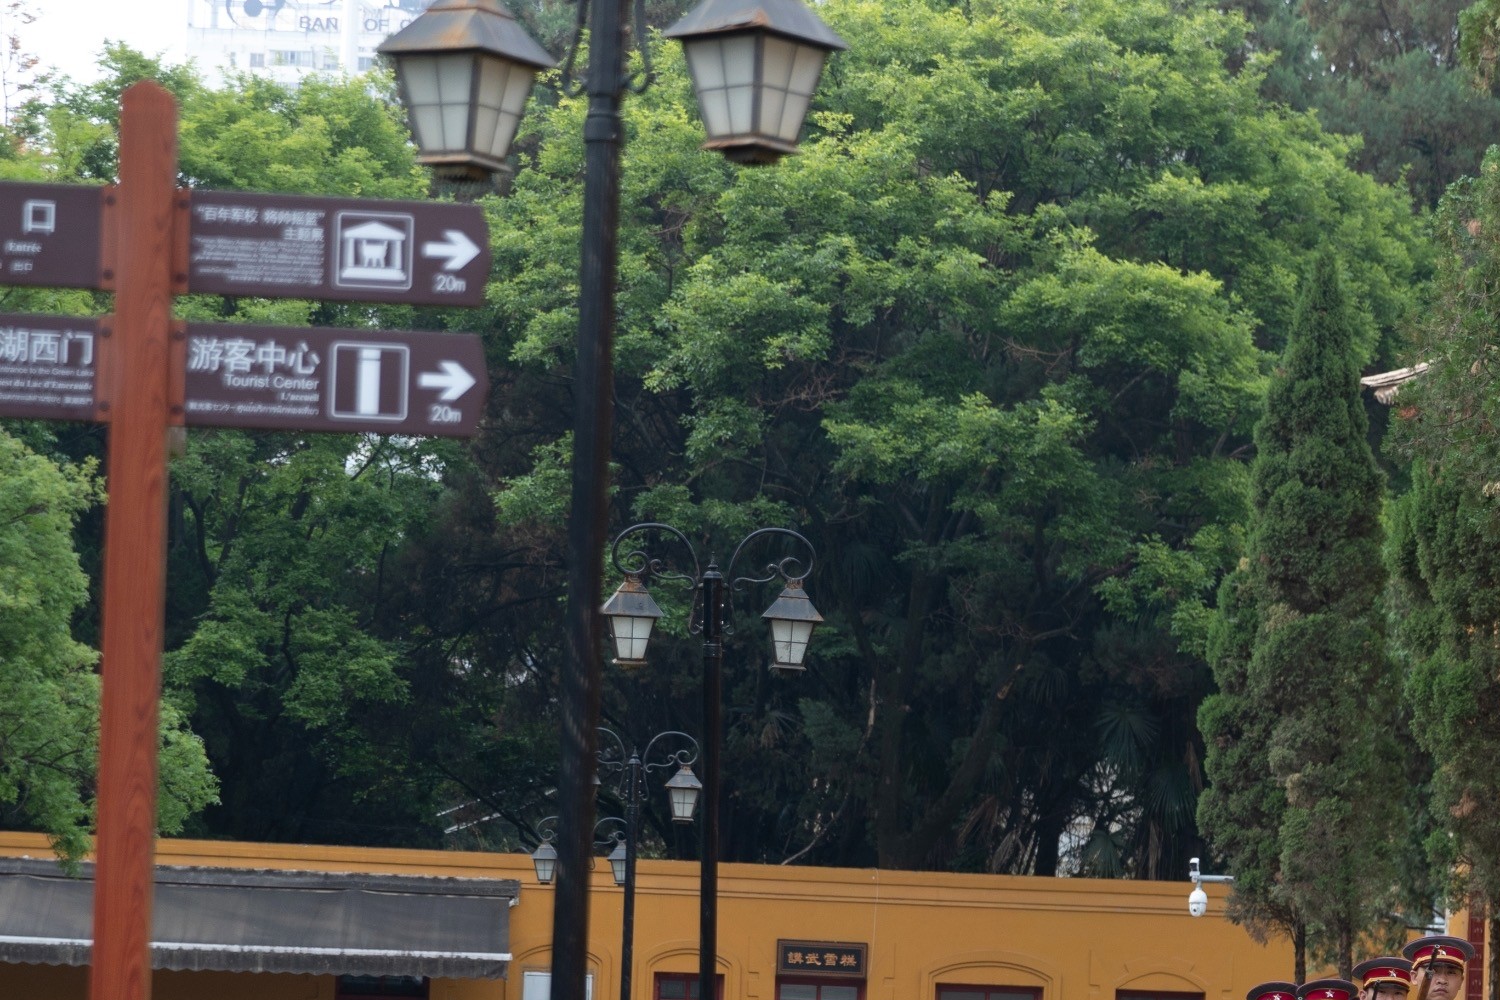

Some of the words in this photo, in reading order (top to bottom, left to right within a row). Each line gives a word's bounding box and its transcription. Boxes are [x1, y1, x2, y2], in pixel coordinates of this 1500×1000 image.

[364, 18, 389, 32] OF
[435, 274, 467, 292] 20m
[0, 329, 94, 365] 湖西门
[190, 337, 320, 374] 游客中心
[225, 373, 270, 388] Tourist
[273, 376, 320, 390] Center
[430, 405, 462, 423] 20m
